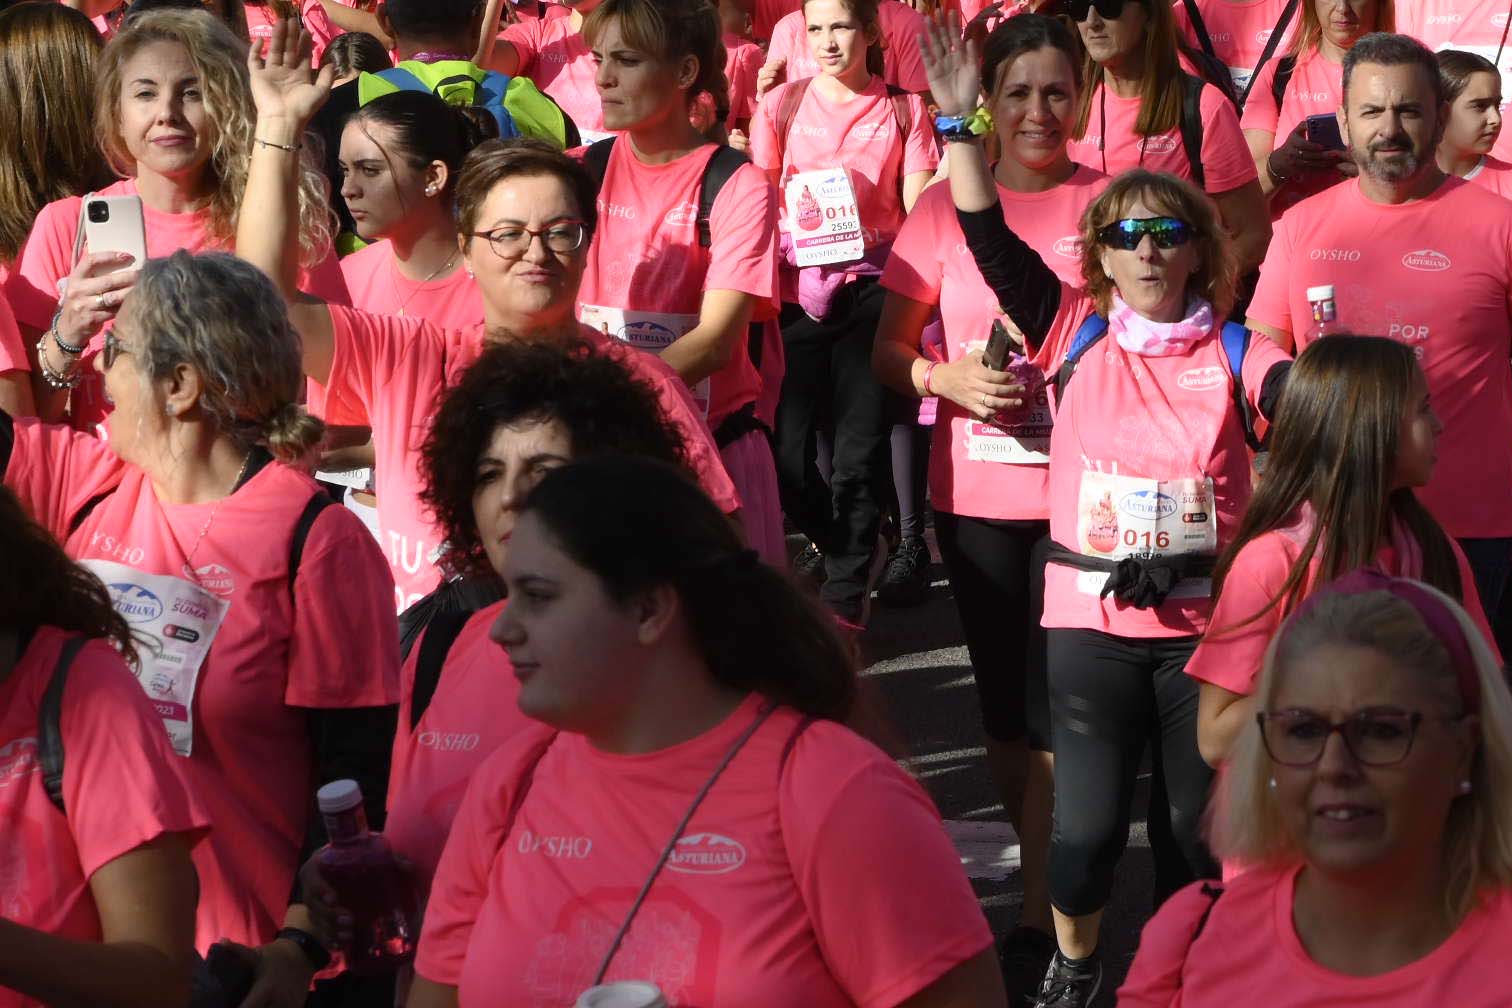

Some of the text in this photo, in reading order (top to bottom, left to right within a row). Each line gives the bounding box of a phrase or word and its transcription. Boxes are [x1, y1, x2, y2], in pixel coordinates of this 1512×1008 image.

[806, 236, 836, 246] CARRERA
[1310, 248, 1361, 262] OYSHO
[1388, 323, 1430, 339] POR
[1123, 499, 1174, 515] ASTURIANA
[1123, 529, 1171, 549] 016
[388, 528, 424, 574] TU
[417, 729, 480, 753] OYSHO
[517, 830, 593, 860] OYSHO
[668, 848, 740, 865] ASTURIANA
